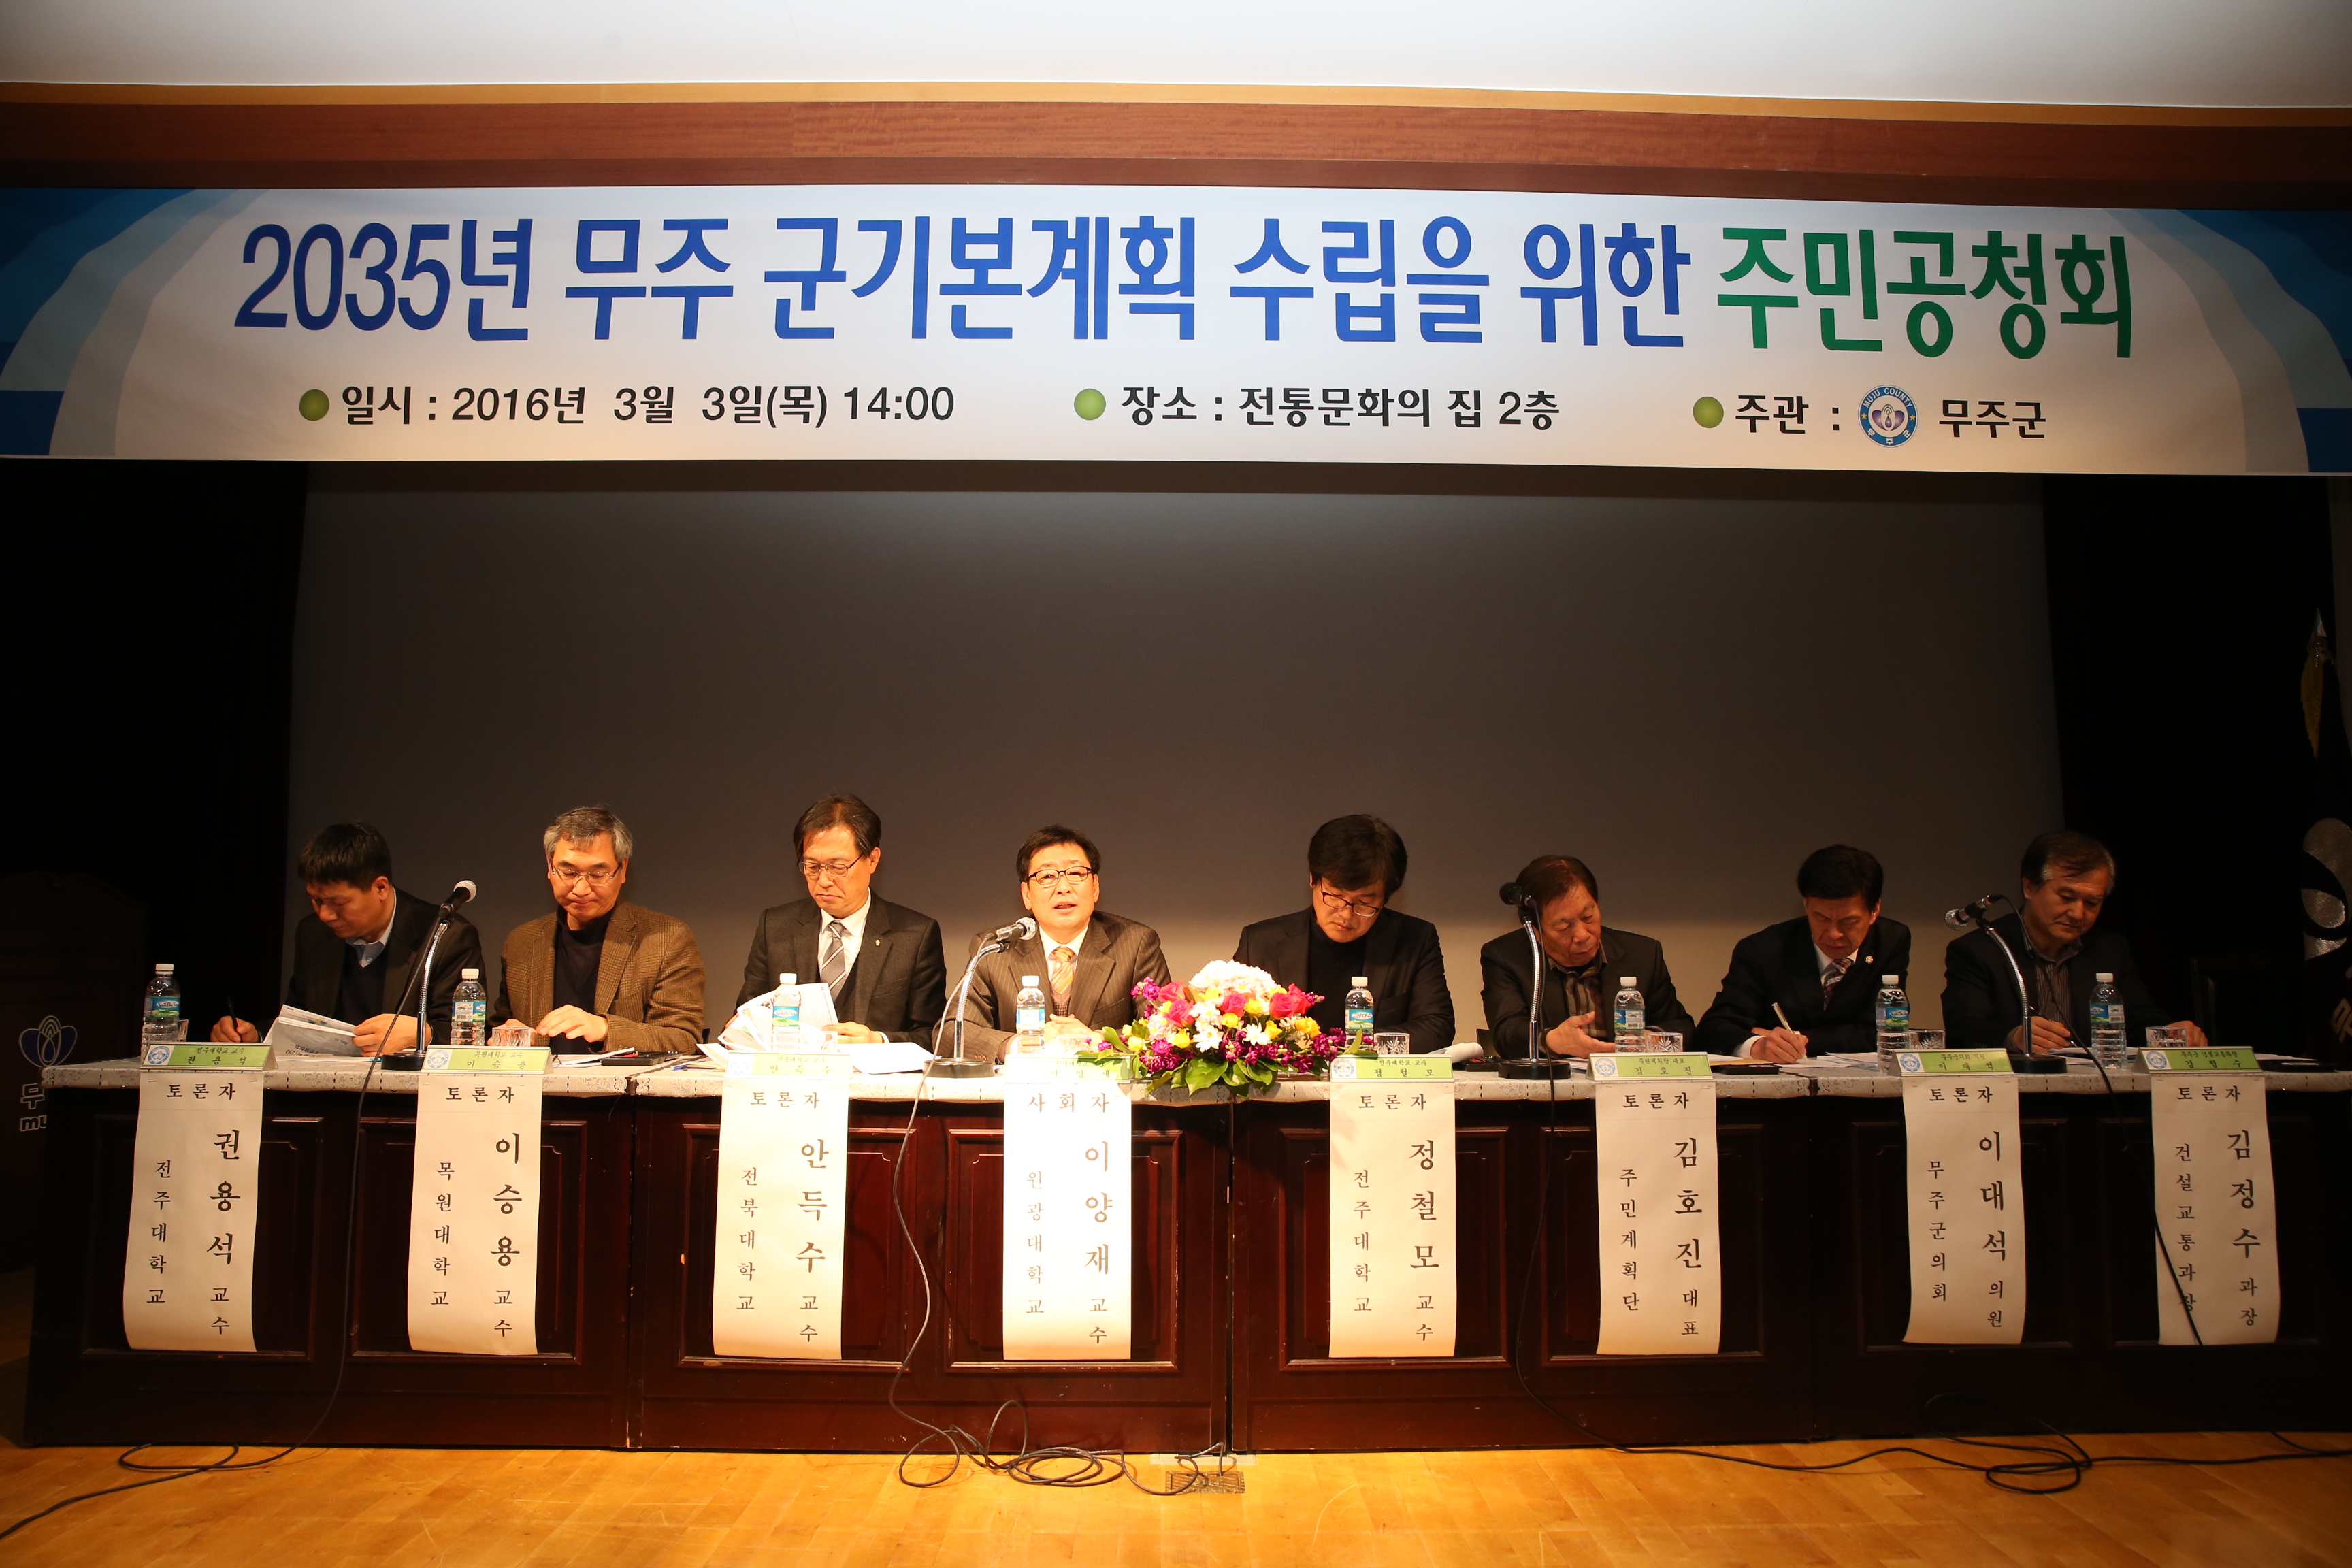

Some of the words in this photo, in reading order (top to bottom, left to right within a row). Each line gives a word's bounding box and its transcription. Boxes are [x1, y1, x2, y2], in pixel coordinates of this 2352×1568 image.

[234, 218, 534, 342] 2035년
[564, 218, 734, 340] 무주
[764, 215, 1195, 340] 군기본계획
[1230, 216, 1490, 344] 수립을
[1520, 223, 1691, 348] 위한
[1717, 227, 2132, 360] 주민공청회
[342, 386, 412, 425] 일시
[451, 387, 586, 424] 2016년
[613, 385, 674, 424] 3월
[702, 385, 828, 429] 3일(목)
[843, 386, 954, 421] 14:00
[1121, 386, 1197, 426] 장소
[1239, 387, 1430, 427] 전통문화의
[1447, 389, 1481, 428] 집
[1499, 390, 1560, 431] 2층
[1735, 395, 1809, 434] 주관
[1938, 399, 2046, 438] 무주군
[1863, 389, 1880, 408] MUJU
[1884, 387, 1913, 408] COUNTY
[166, 1082, 236, 1100] 토론자
[446, 1086, 514, 1104] 토론자
[750, 1092, 820, 1109] 토론자
[1028, 1092, 1110, 1113] 사회자
[1358, 1093, 1427, 1111] 토론자
[1623, 1092, 1690, 1109] 토론자
[1929, 1085, 1993, 1103] 토론자
[2176, 1085, 2241, 1102] 토론자
[206, 1129, 241, 1265] 권용석
[490, 1132, 523, 1267] 이승용
[796, 1139, 830, 1273] 안득수
[1085, 1141, 1113, 1275] 이양재
[1409, 1139, 1439, 1269] 정철모
[1674, 1137, 1703, 1269] 김호진
[1978, 1130, 2006, 1262] 이대석
[2227, 1129, 2261, 1259] 김정수
[146, 1159, 172, 1304] 전주대학교
[430, 1162, 455, 1305] 목원대학교
[736, 1167, 758, 1310] 전북대학교
[1026, 1171, 1044, 1313] 원광대학교
[1353, 1169, 1372, 1311] 전주대학교
[1620, 1169, 1640, 1311] 주민계획단
[1927, 1161, 1946, 1302] 무주군의회
[210, 1288, 230, 1335] 교수
[493, 1290, 512, 1338] 교수
[800, 1296, 819, 1343] 교수
[1089, 1298, 1107, 1344] 교수
[1415, 1295, 1435, 1341] 교수
[1681, 1288, 1699, 1335] 대표
[1987, 1280, 2003, 1328] 의원
[2239, 1277, 2258, 1326] 과장
